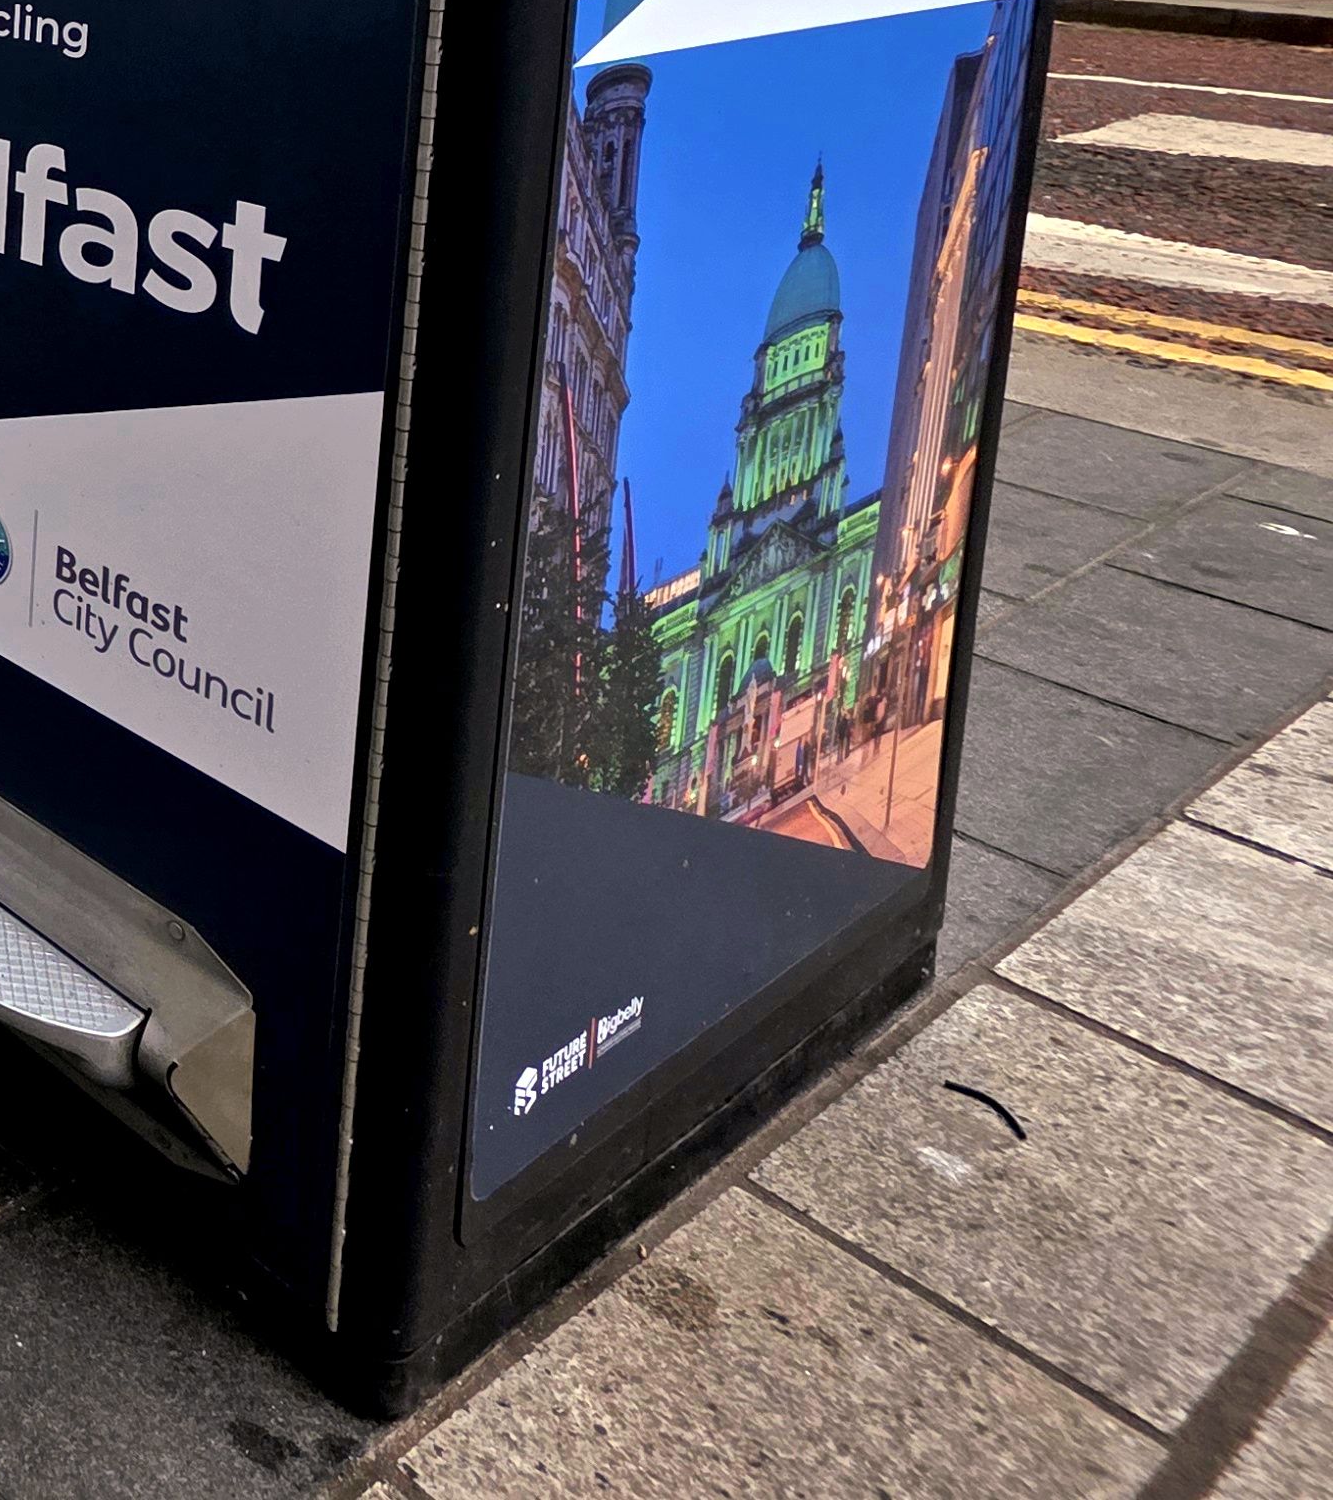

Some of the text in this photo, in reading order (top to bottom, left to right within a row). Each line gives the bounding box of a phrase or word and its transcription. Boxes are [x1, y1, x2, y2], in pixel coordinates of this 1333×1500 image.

[55, 545, 189, 643] Belfast
[53, 588, 275, 734] City Council
[596, 995, 645, 1045] Bigbelly
[540, 1048, 587, 1095] STREET
[542, 1029, 588, 1078] FUTURE
